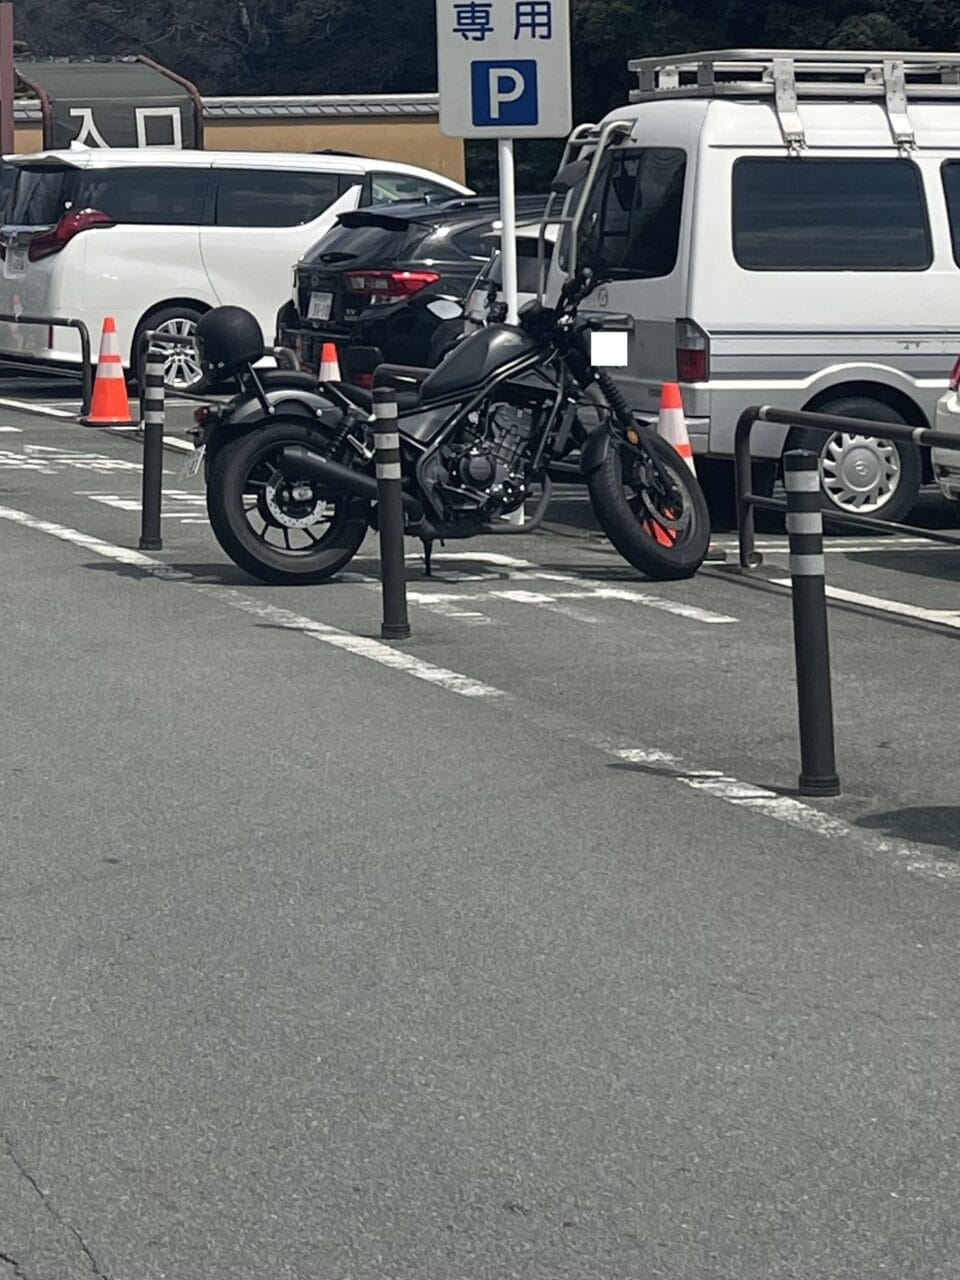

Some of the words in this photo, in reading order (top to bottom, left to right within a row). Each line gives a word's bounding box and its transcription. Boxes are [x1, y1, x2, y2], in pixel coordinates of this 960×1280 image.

[452, 0, 552, 42] 専用
[487, 67, 526, 120] P
[69, 106, 183, 150] 入口
